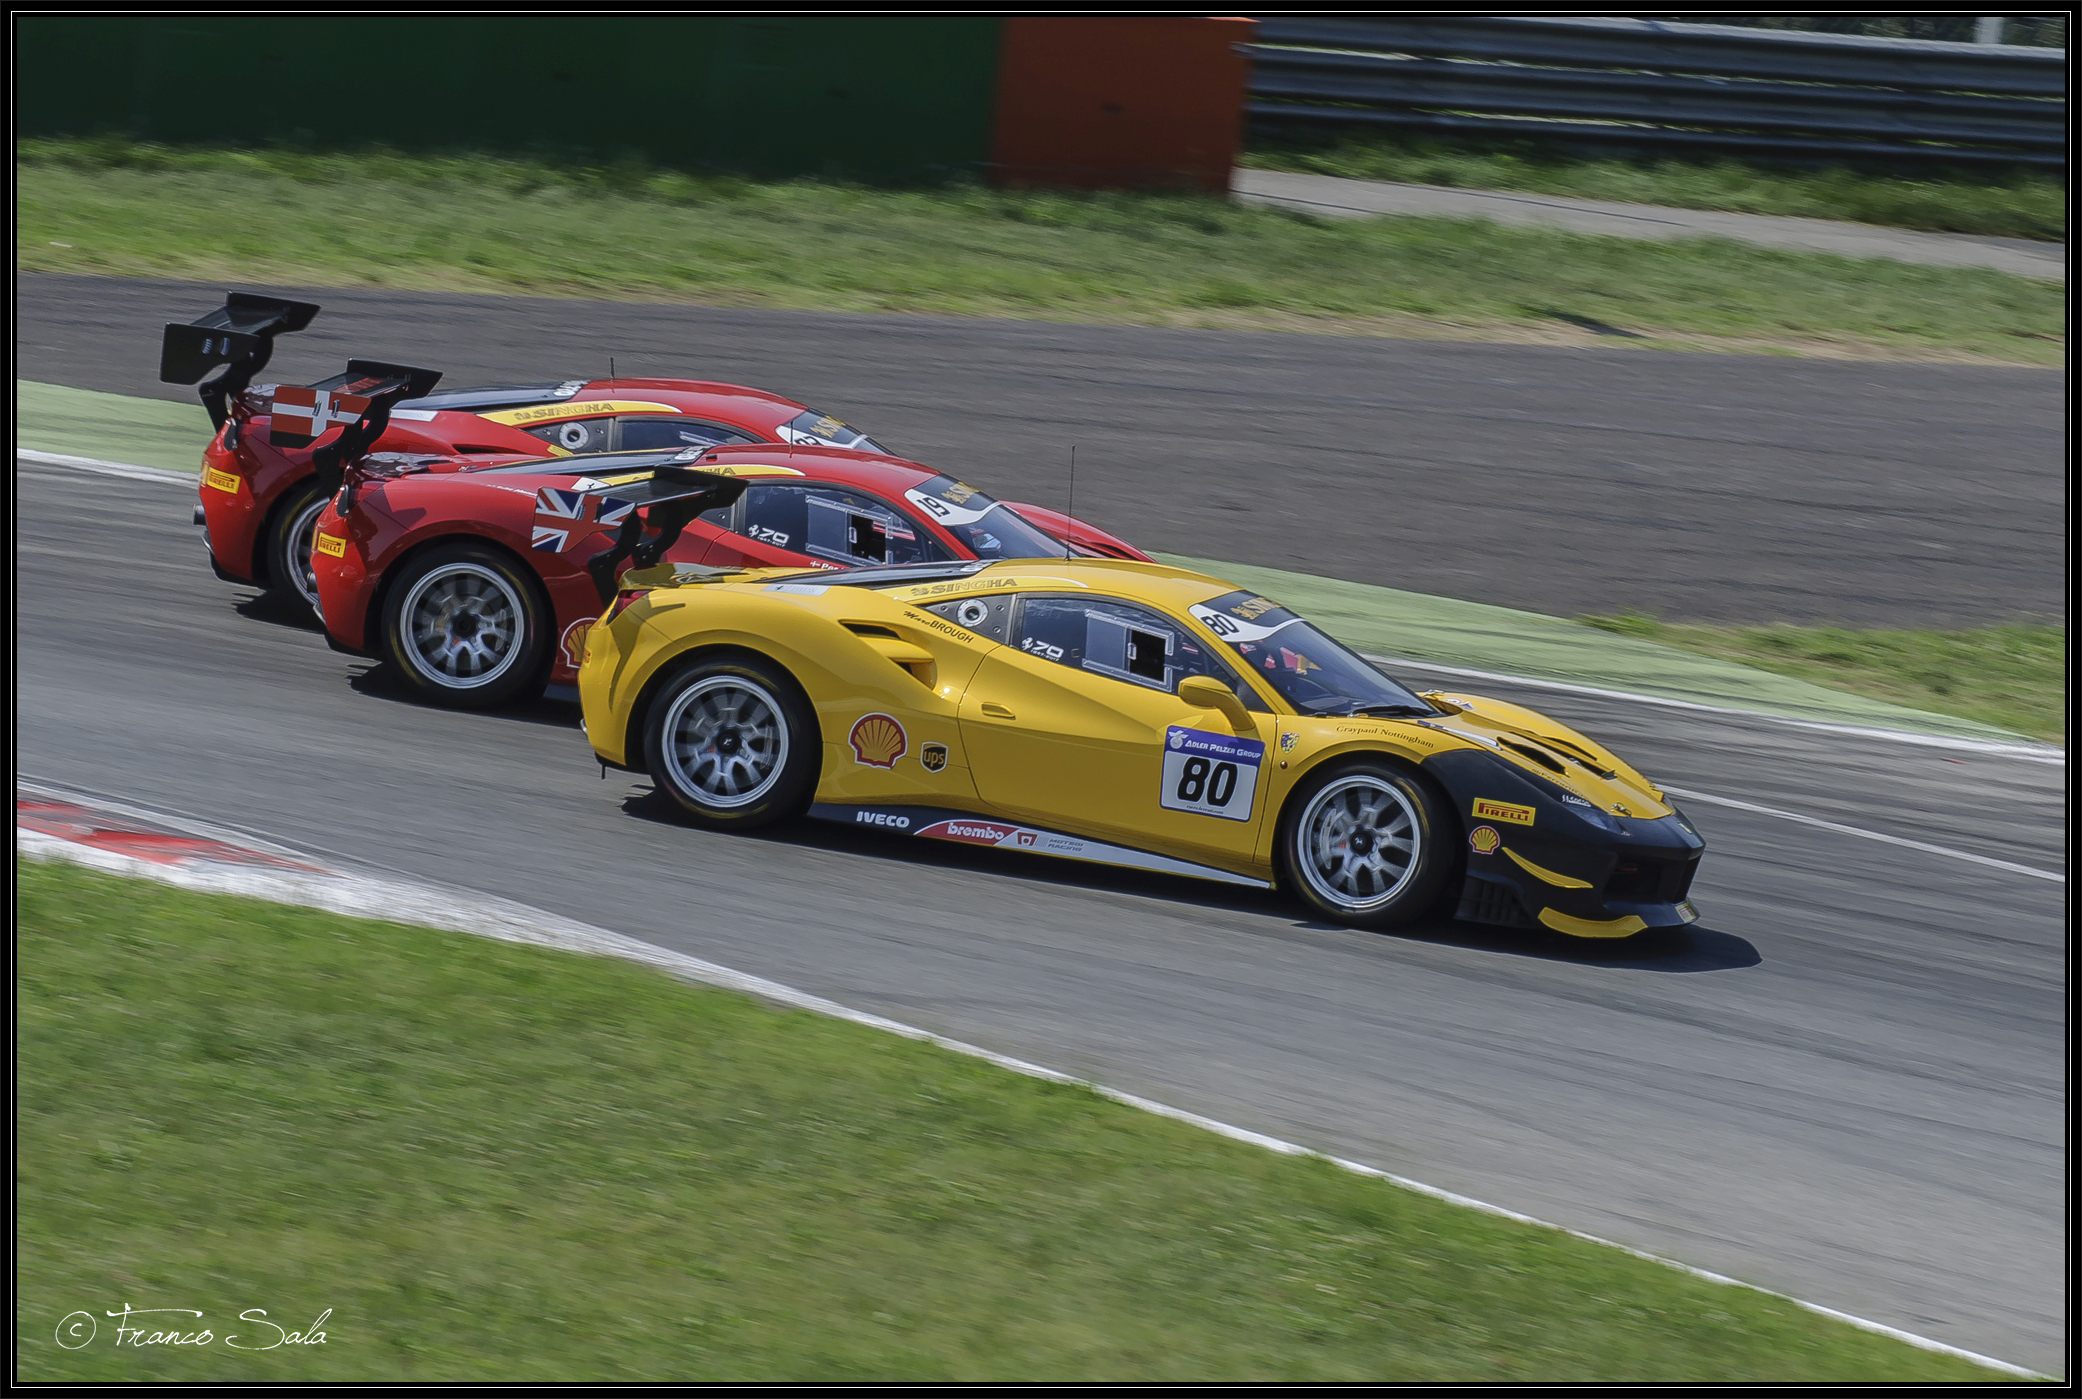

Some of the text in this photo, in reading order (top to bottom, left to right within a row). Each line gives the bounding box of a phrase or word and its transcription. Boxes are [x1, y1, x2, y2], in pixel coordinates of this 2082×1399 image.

[533, 403, 615, 419] SINGHA
[916, 497, 951, 517] 19
[759, 527, 790, 544] 70
[930, 578, 1018, 594] SINGHA
[929, 620, 975, 644] BROUGH
[1200, 614, 1240, 636] 80
[1032, 640, 1064, 658] 70
[1336, 726, 1434, 748] Graypaul Nottingham
[923, 751, 945, 768] ups
[1177, 756, 1238, 808] 80
[856, 811, 910, 828] IVECO
[1478, 802, 1530, 821] PIRELLI
[947, 823, 1005, 841] brembo
